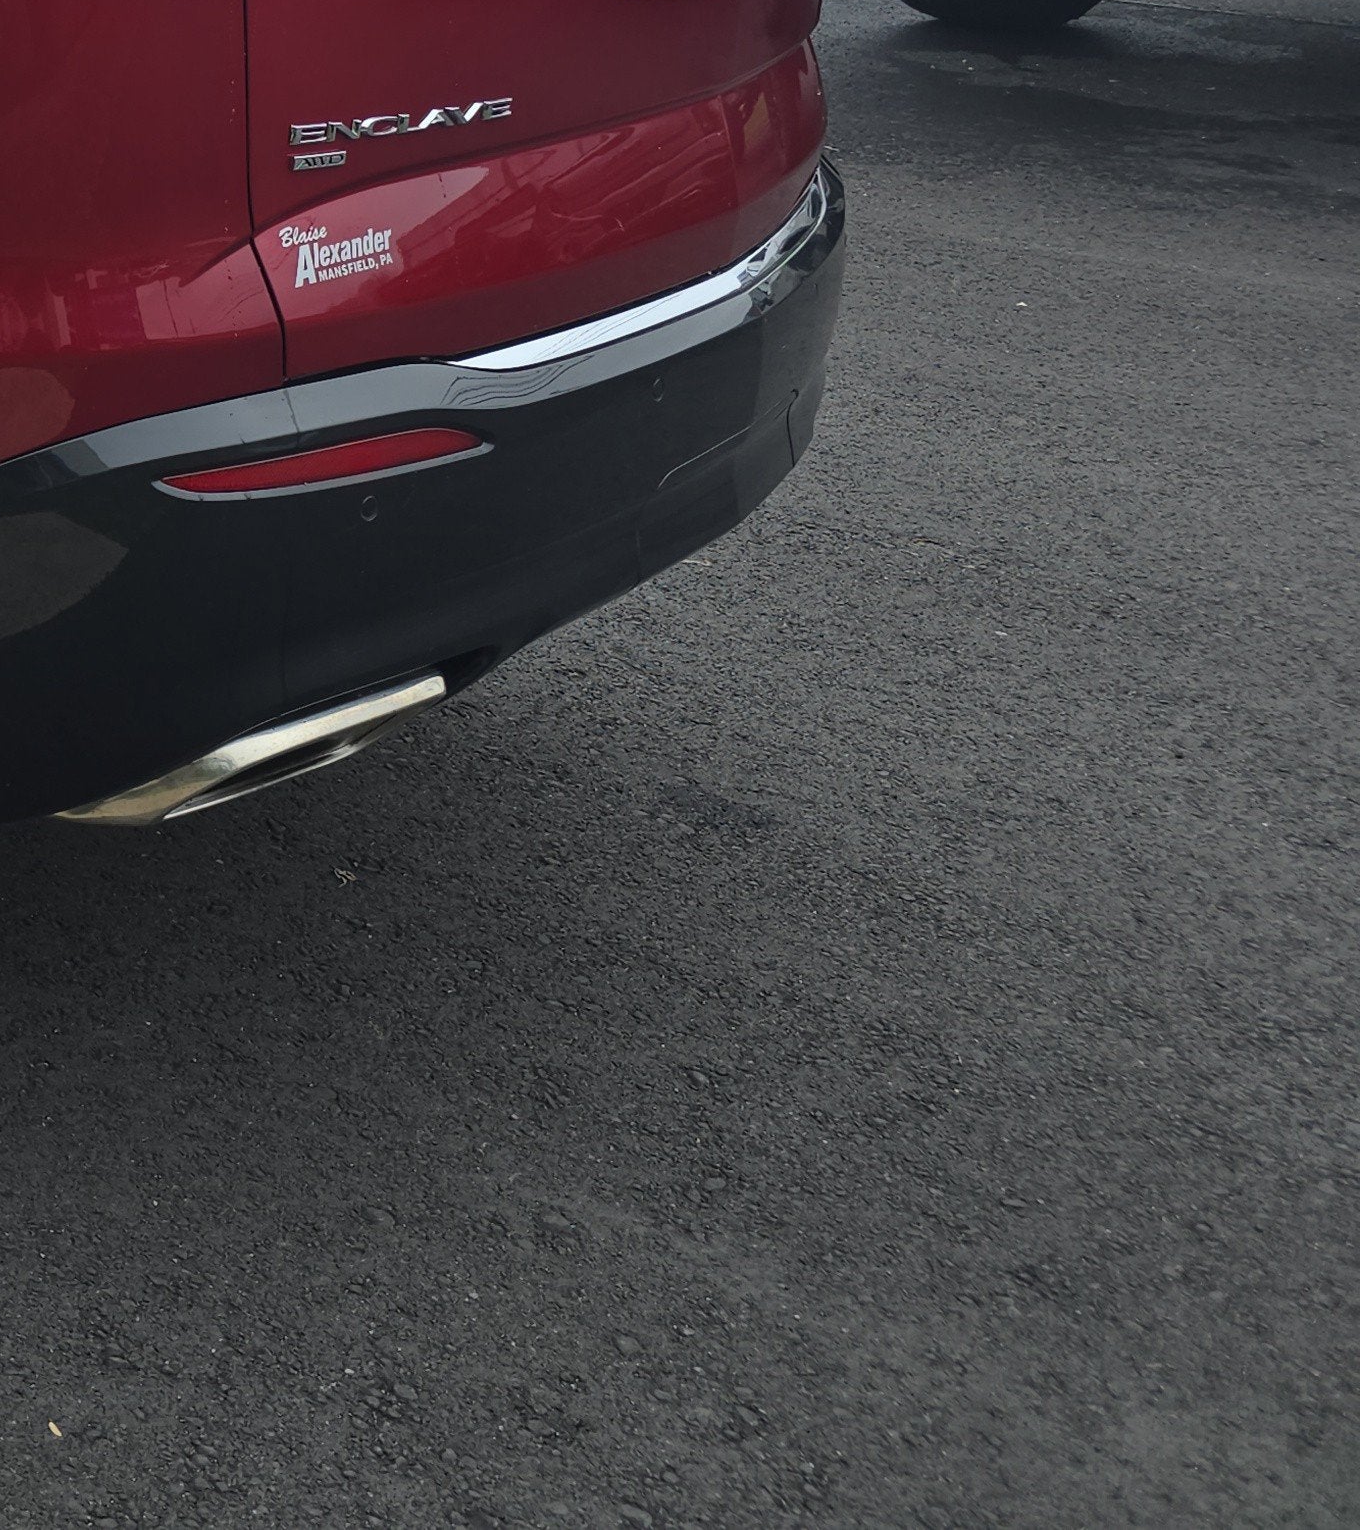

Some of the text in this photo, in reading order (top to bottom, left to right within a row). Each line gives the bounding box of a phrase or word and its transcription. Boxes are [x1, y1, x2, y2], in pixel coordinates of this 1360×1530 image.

[289, 97, 513, 145] ENCLAVE
[300, 154, 344, 168] AWD
[279, 225, 328, 248] Blaise
[294, 228, 392, 288] Alexander
[318, 253, 394, 282] MANSFIELD, PA
